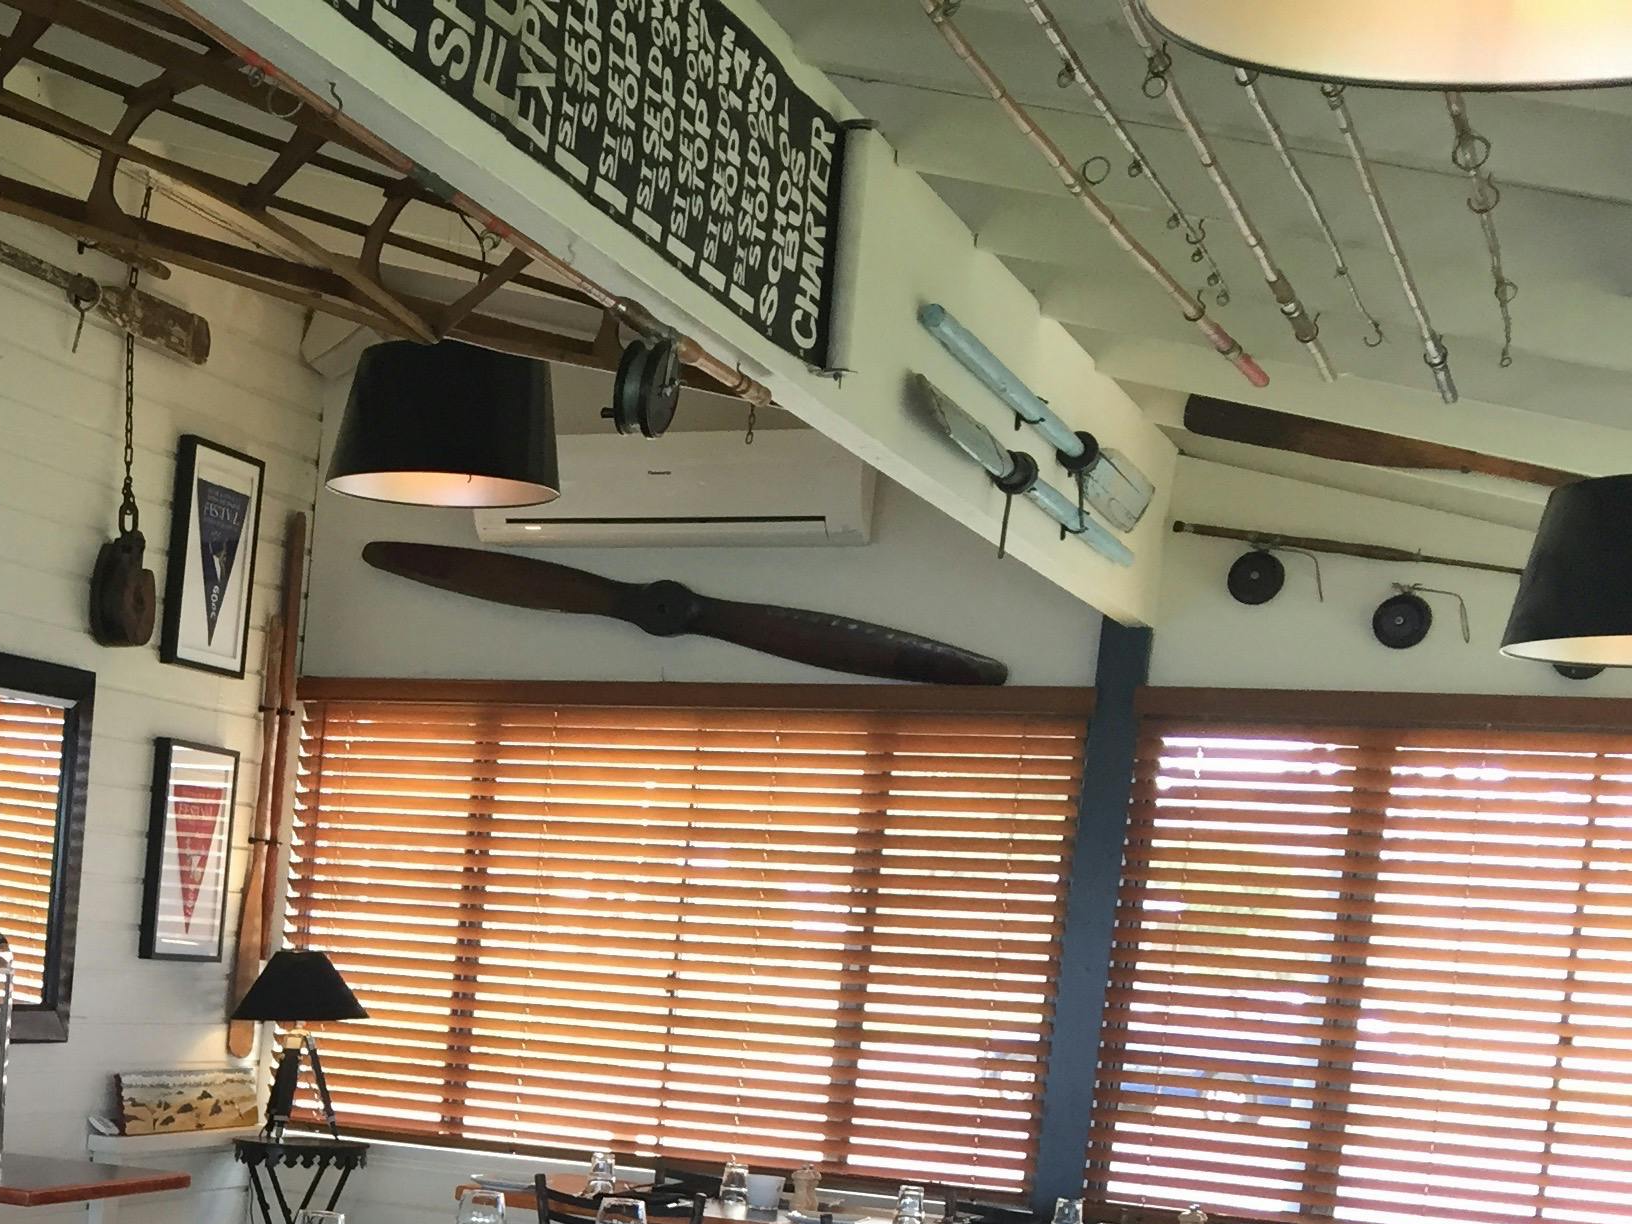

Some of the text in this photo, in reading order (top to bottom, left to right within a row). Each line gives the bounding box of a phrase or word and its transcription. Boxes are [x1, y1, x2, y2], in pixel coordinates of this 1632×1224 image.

[564, 4, 584, 93] SET
[581, 0, 603, 133] STOP
[606, 42, 626, 129] SET
[621, 31, 642, 165] STOP
[717, 25, 736, 139] DOWN
[643, 78, 662, 159] SET
[658, 66, 676, 196] STOP
[678, 109, 695, 189] SET
[692, 8, 716, 221] STOP 37
[709, 139, 727, 217] SET
[722, 46, 751, 247] STOP 14
[738, 166, 756, 241] SET
[747, 56, 767, 166] DOWN
[750, 72, 777, 270] STOP 20
[759, 97, 789, 326] SCHOOL
[784, 148, 806, 272] BUS
[790, 116, 837, 350] CHARTER
